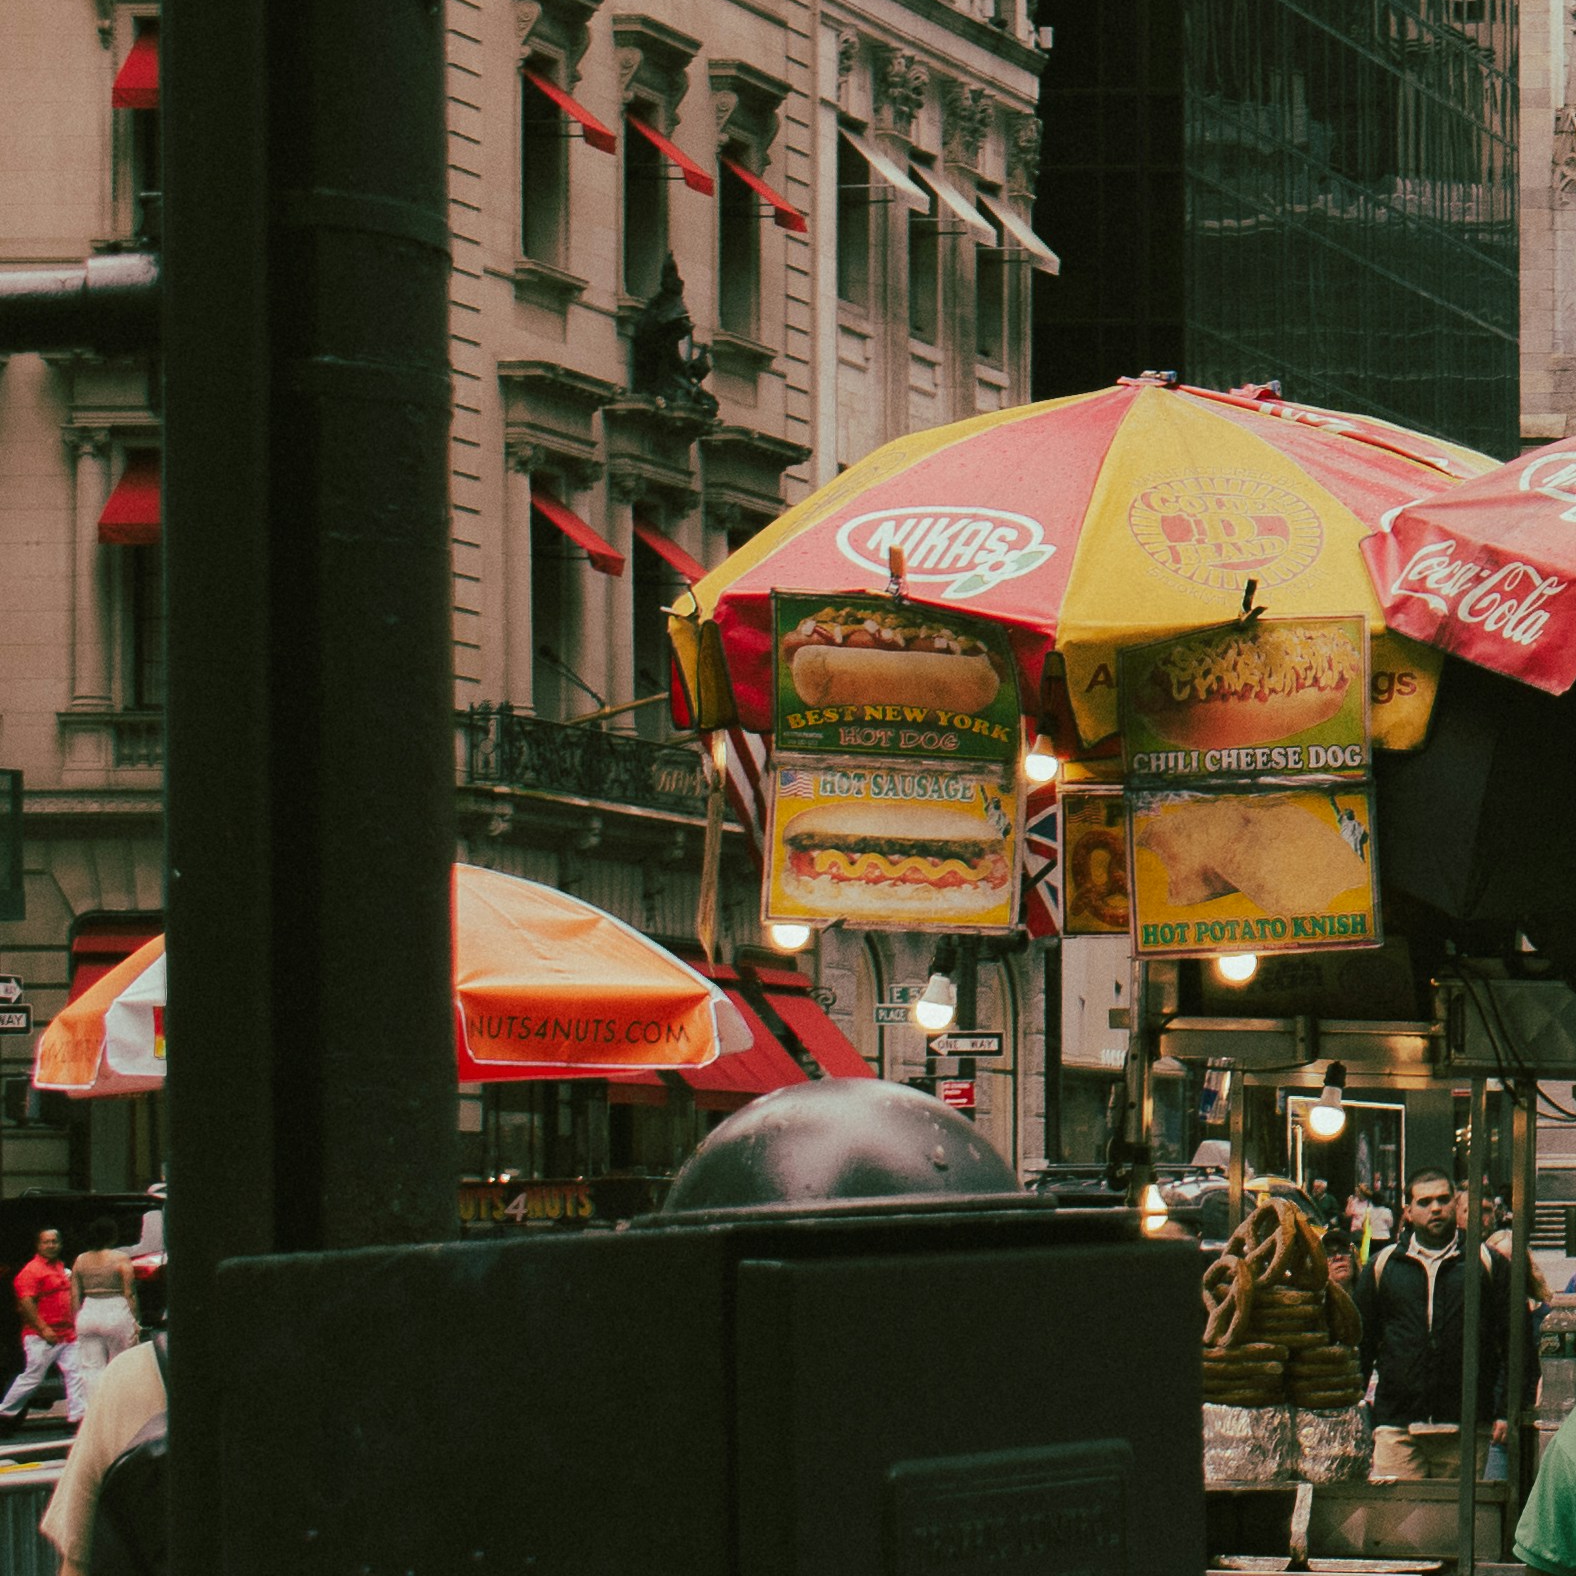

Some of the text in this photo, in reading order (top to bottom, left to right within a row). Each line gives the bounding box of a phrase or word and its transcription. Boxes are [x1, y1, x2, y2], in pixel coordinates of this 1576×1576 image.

[866, 517, 1019, 569] NIKAS
[1390, 539, 1568, 646] Coca-Cola
[786, 704, 1011, 743] BEST NEW YORK
[838, 727, 894, 748] HOT
[899, 729, 960, 751] DOG
[1133, 744, 1362, 774] CHILI CHEESE DOG
[819, 773, 978, 802] HOT SAUSAGE
[1142, 912, 1368, 946] HOT POTATO KNISH
[893, 987, 903, 1003] E
[469, 1015, 691, 1044] NUTS4NUTS.COM
[878, 1008, 907, 1022] PLACE
[937, 1039, 994, 1050] ONE WAY
[458, 1184, 594, 1222] UTS4NUTS
